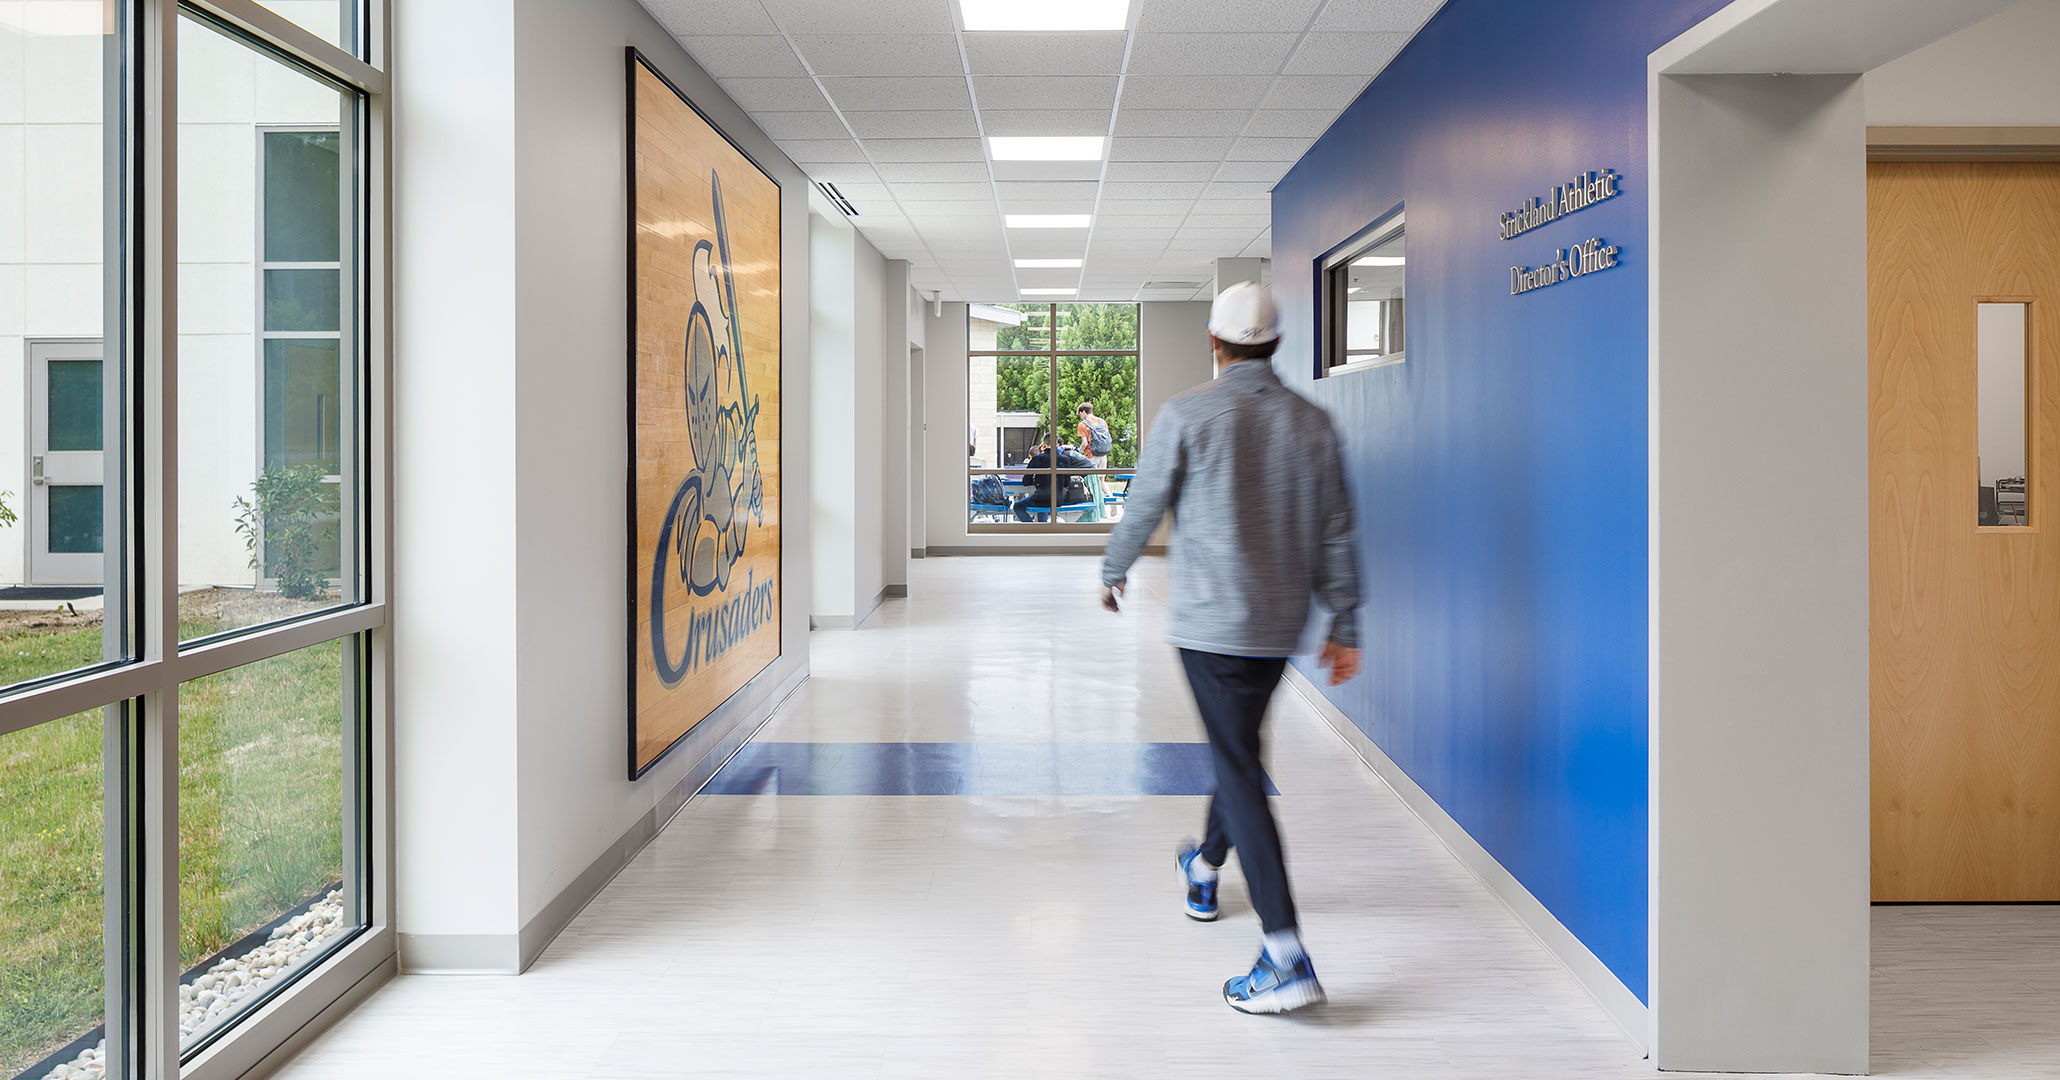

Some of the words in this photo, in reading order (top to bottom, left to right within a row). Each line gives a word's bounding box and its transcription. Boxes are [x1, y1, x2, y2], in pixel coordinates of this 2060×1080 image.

[1499, 188, 1560, 241] Strickland
[1558, 168, 1619, 216] Athletic
[1510, 248, 1570, 296] Director's
[1569, 237, 1619, 278] Office
[651, 472, 774, 690] Crusaders
